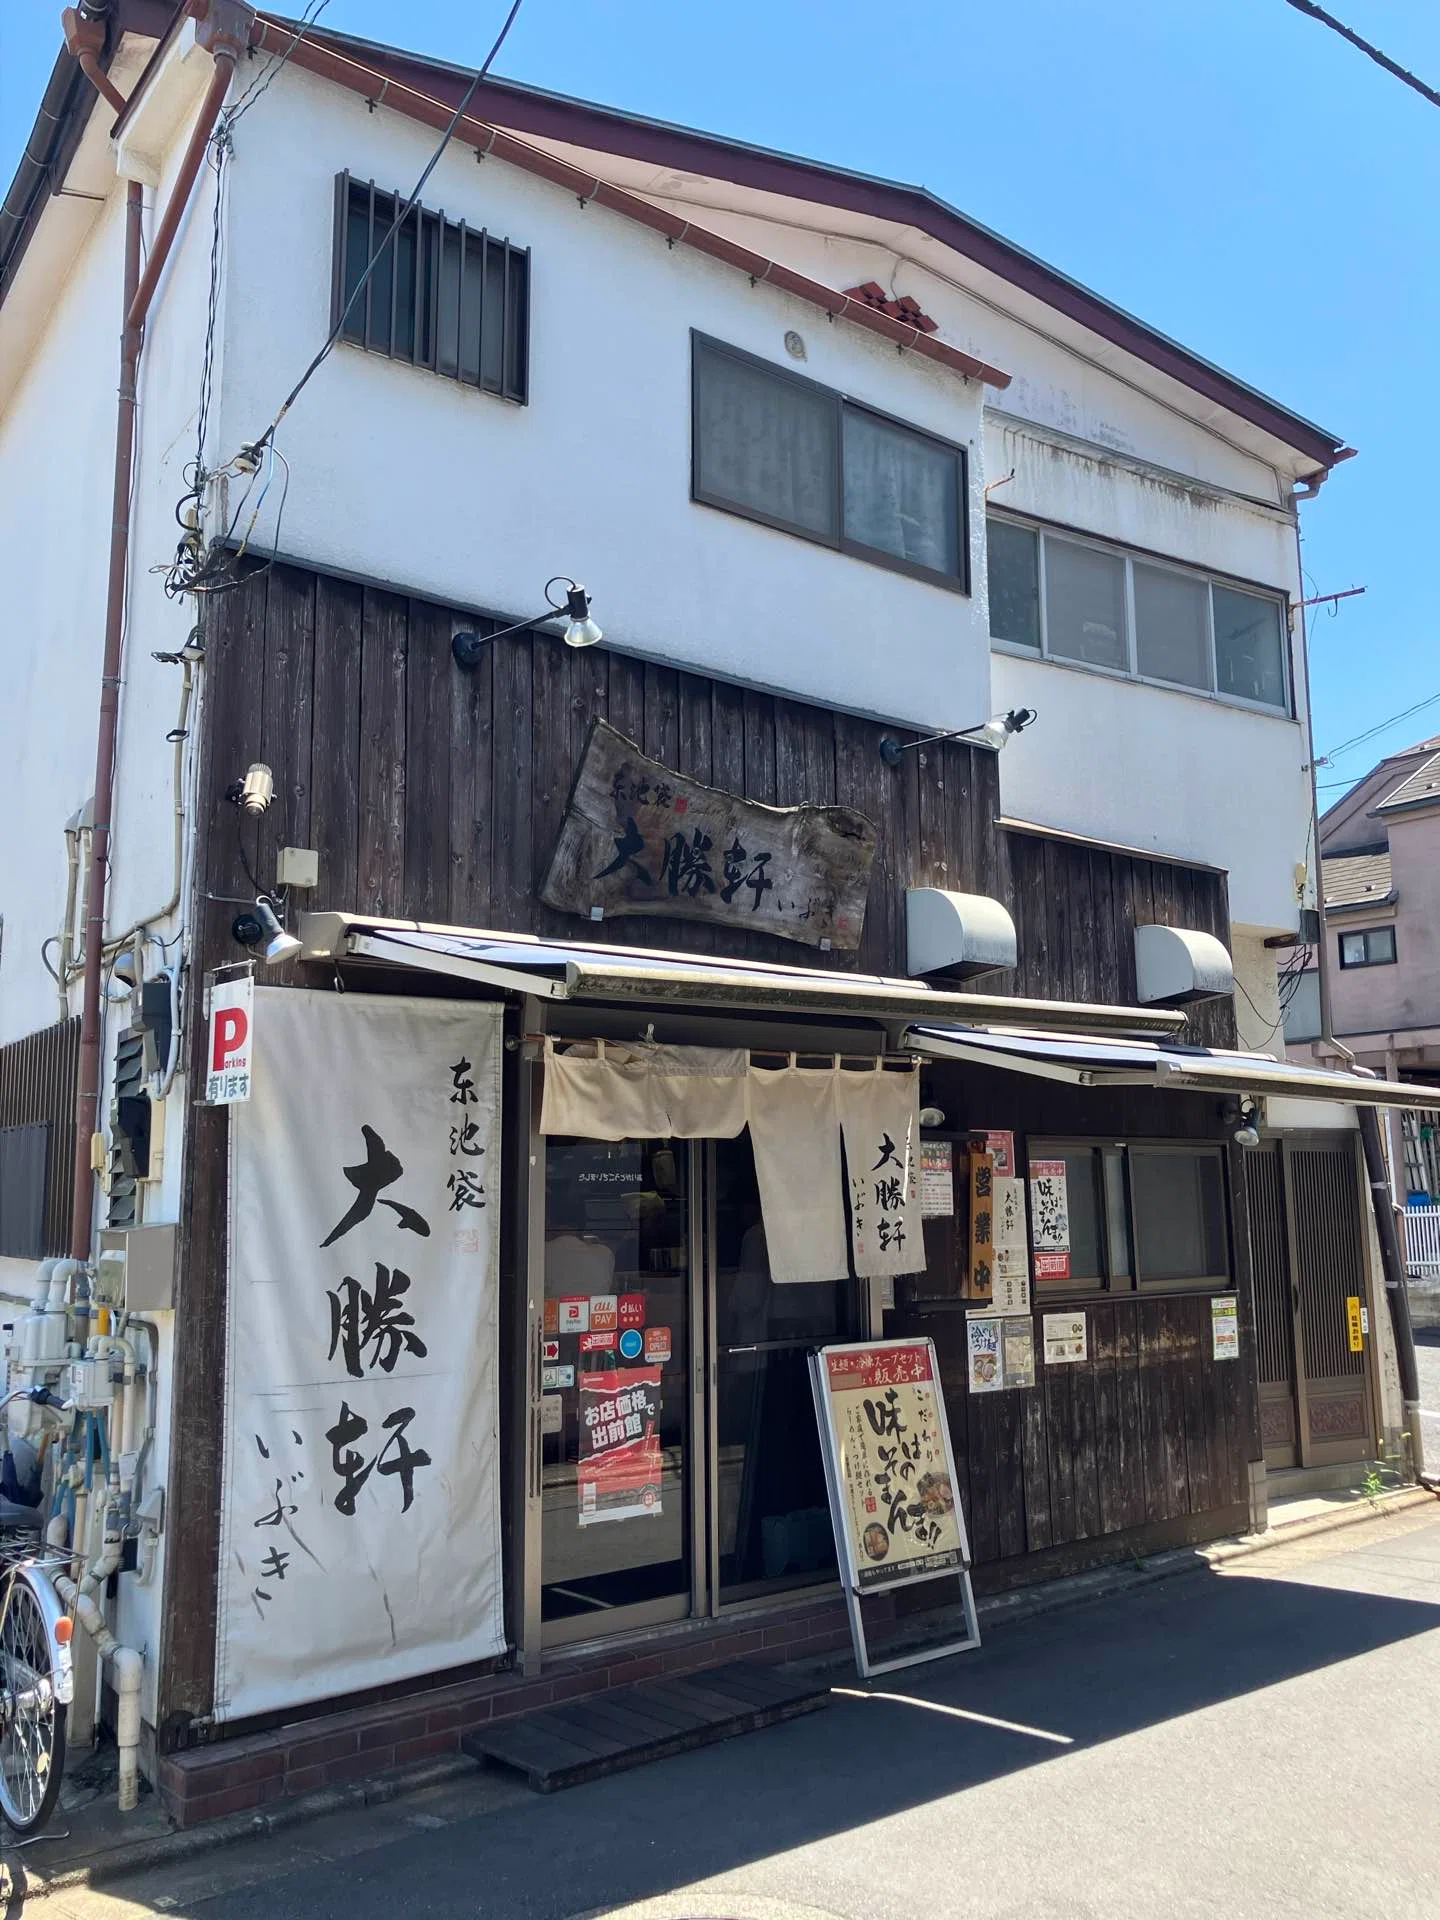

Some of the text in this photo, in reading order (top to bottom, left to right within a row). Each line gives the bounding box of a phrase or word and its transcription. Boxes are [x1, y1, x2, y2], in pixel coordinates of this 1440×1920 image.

[593, 816, 774, 912] 大勝軒
[208, 1074, 249, 1099] 有ります
[852, 1177, 865, 1237] いぶき
[871, 1132, 906, 1252] 大勝軒
[975, 1166, 991, 1293] 営業中
[320, 1124, 431, 1517] 大勝軒
[594, 1314, 612, 1325] PAY
[874, 1363, 925, 1385] 販売中
[584, 1389, 656, 1427] お店価格で
[591, 1412, 642, 1450] 出前館
[916, 1388, 934, 1462] こだわり
[254, 1430, 305, 1602] いぶき
